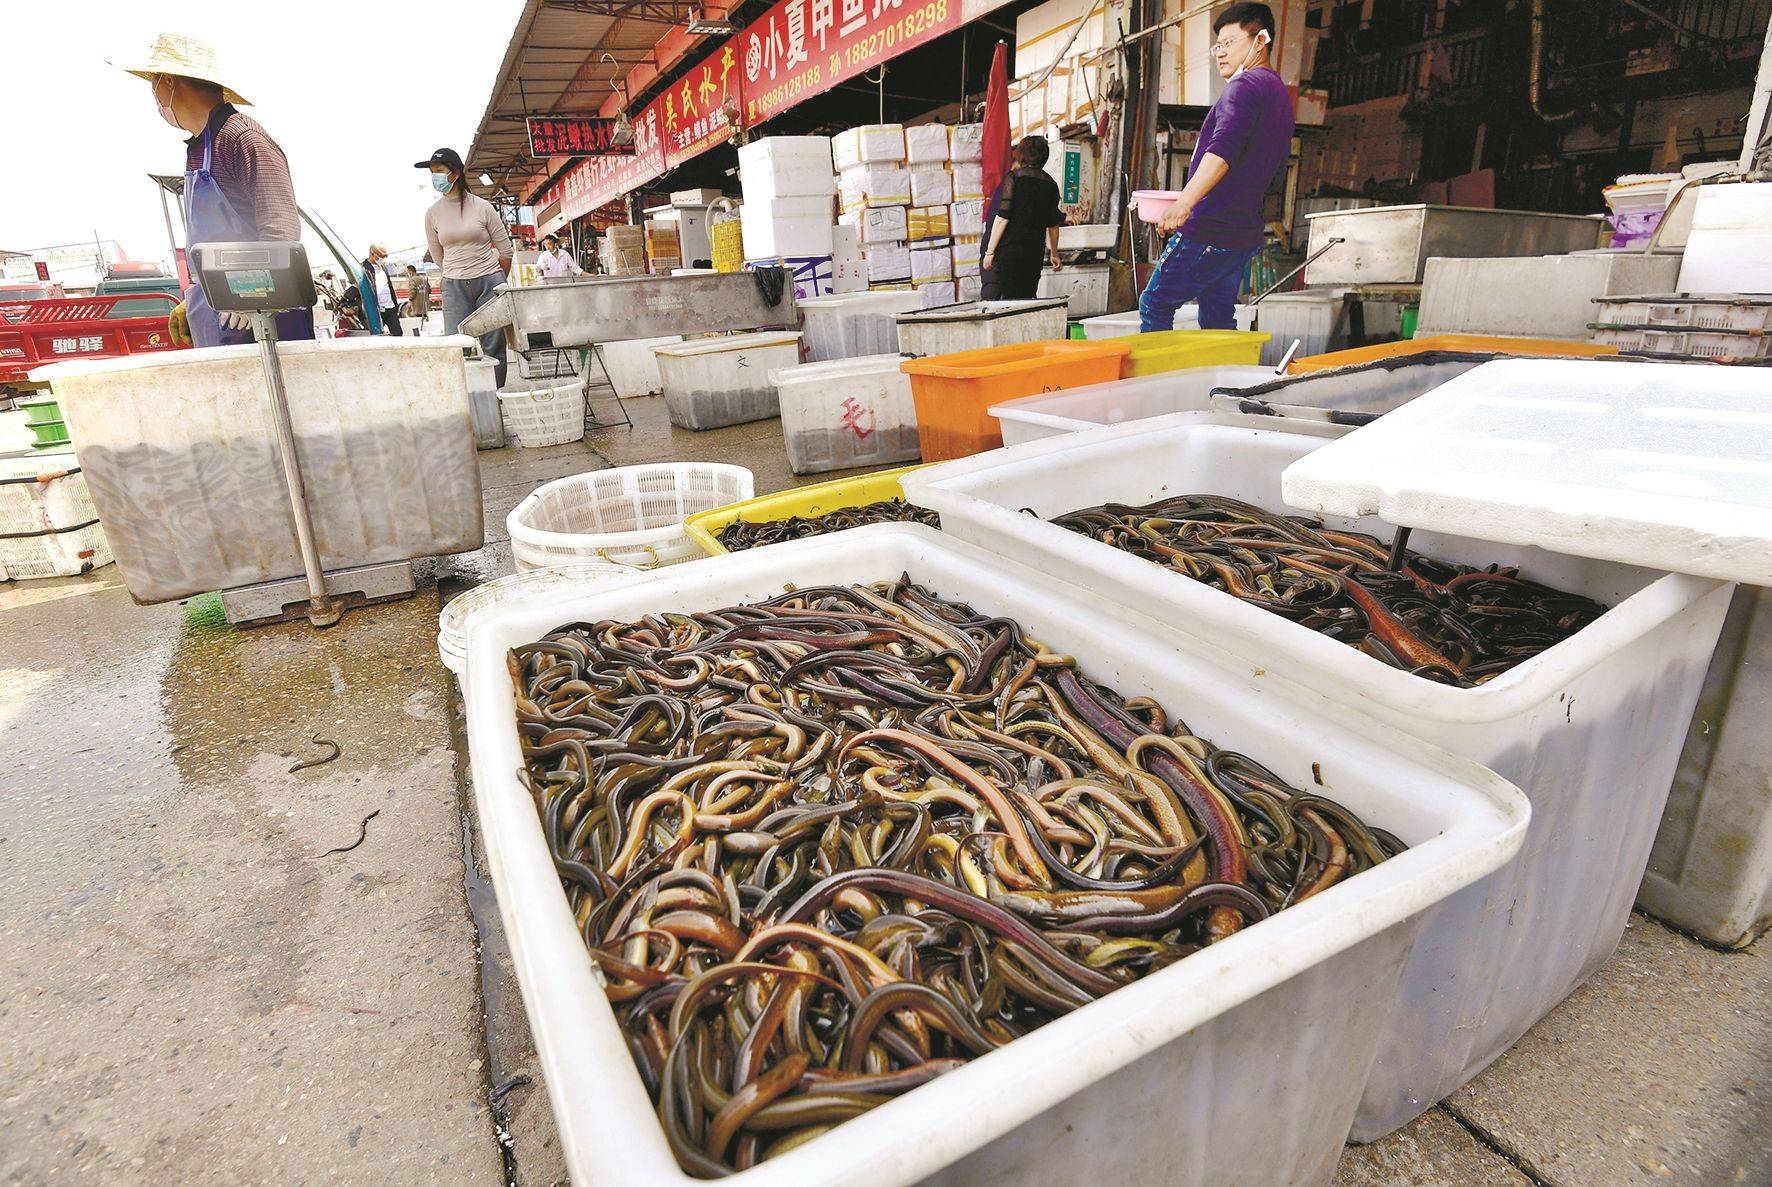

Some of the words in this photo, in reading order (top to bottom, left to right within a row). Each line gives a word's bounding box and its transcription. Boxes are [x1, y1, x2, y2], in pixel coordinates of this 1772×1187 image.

[757, 65, 820, 113] 18986128188
[845, 0, 947, 67] 18827018298
[764, 0, 900, 80] 小夏甲鱼
[666, 46, 735, 134] 吴氏水产
